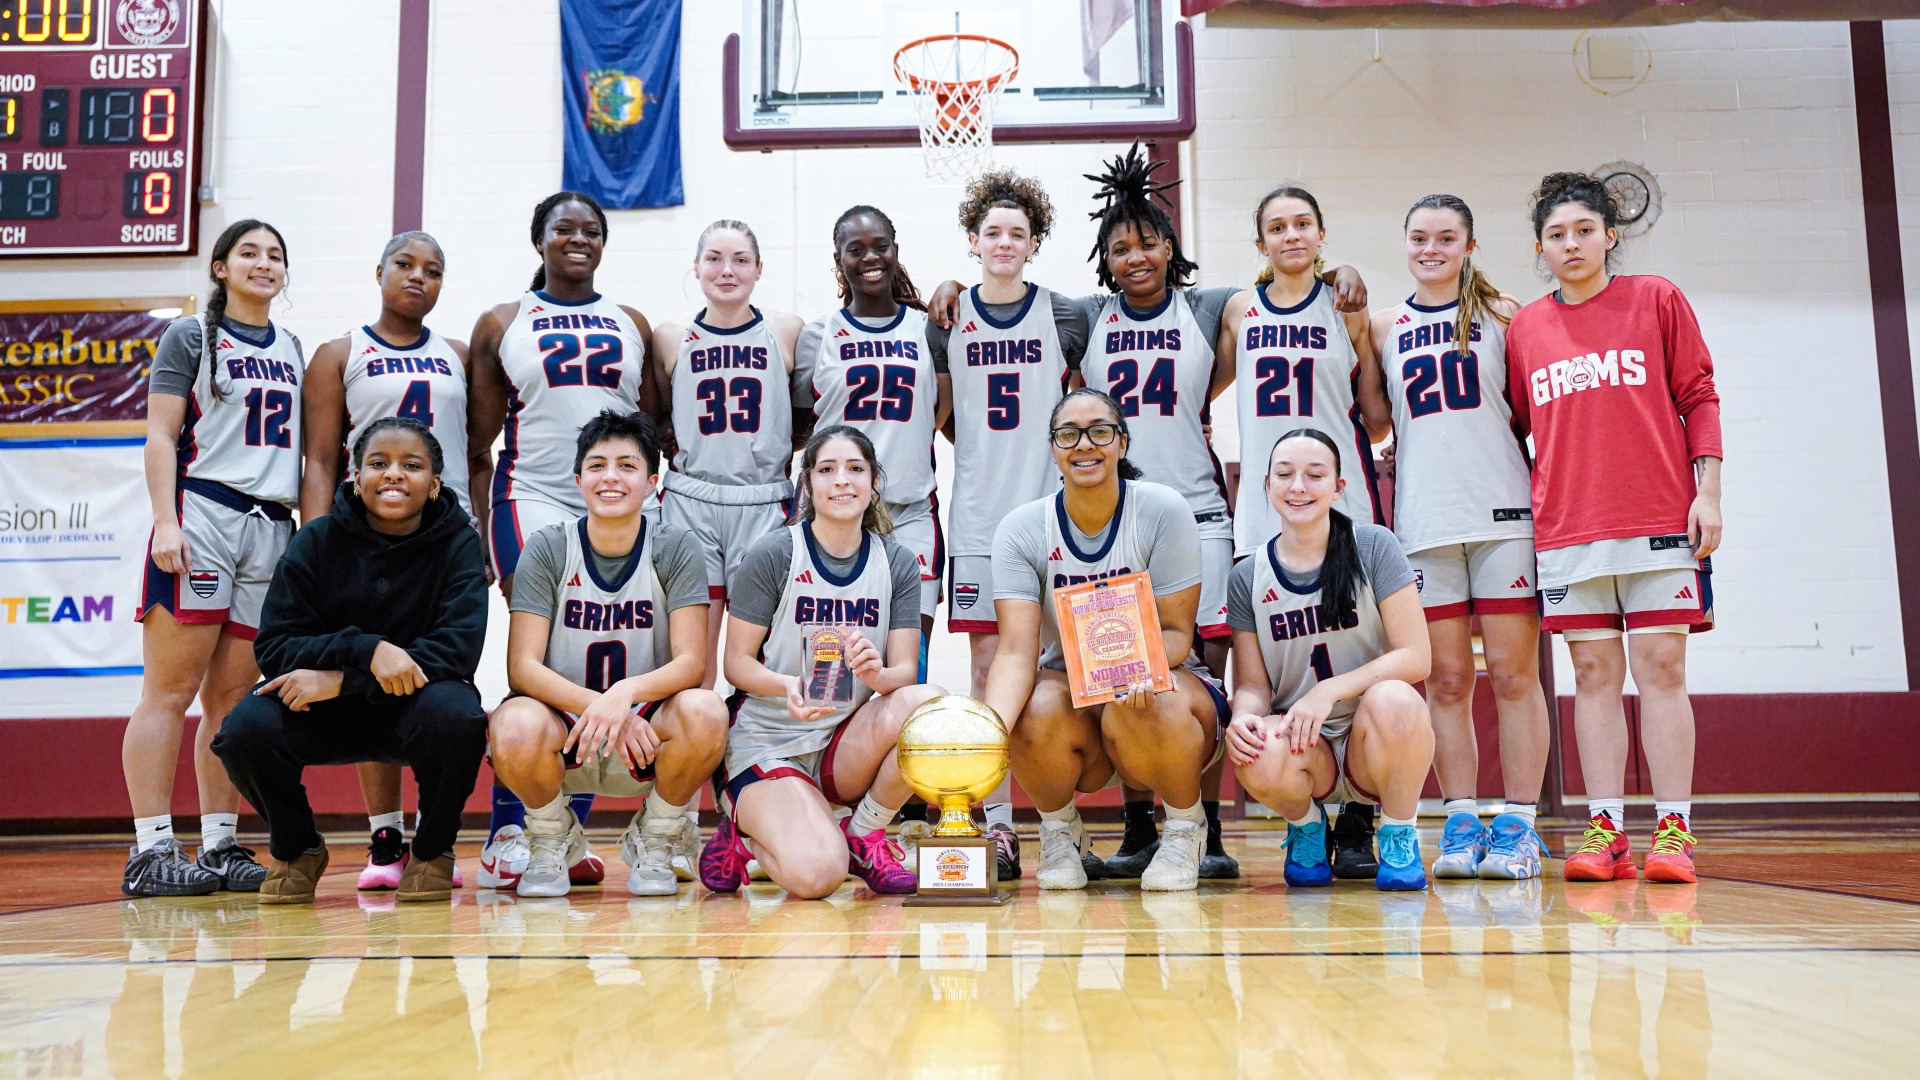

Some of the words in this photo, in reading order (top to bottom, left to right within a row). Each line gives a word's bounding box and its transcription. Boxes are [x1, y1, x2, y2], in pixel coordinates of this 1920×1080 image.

[90, 54, 173, 79] GUEST
[23, 152, 67, 170] FOUL
[129, 151, 184, 169] FOULS
[121, 224, 177, 243] SCORE
[532, 314, 621, 332] GRIMS
[840, 340, 919, 361] GRIMS
[1106, 328, 1182, 355] GRIMS
[1246, 325, 1327, 351] GRIMS
[1398, 321, 1482, 355] GRIMS
[366, 357, 452, 377] GRIMS
[538, 333, 623, 390] 22
[691, 345, 768, 373] GRIMS
[966, 339, 1042, 367] GRIMS
[226, 356, 298, 386] GRIMS
[1402, 349, 1482, 420] 20
[844, 364, 916, 422] 25
[1107, 357, 1178, 418] 24
[1256, 356, 1314, 417] 21
[396, 380, 434, 432] 4
[697, 376, 762, 436] 33
[987, 372, 1020, 431] 5
[244, 387, 292, 448] 12
[1, 533, 52, 544] DEVELOP
[58, 532, 115, 543] DEDICATE
[3, 595, 113, 623] TEAM
[1072, 600, 1100, 616] NORWICH
[1102, 594, 1137, 609] UNIVERSITY
[1088, 589, 1118, 603] 2025
[563, 599, 654, 632] GRIMS
[795, 595, 880, 628] GRIMS
[1090, 660, 1146, 683] WOMEN'S
[1310, 642, 1336, 683] 1
